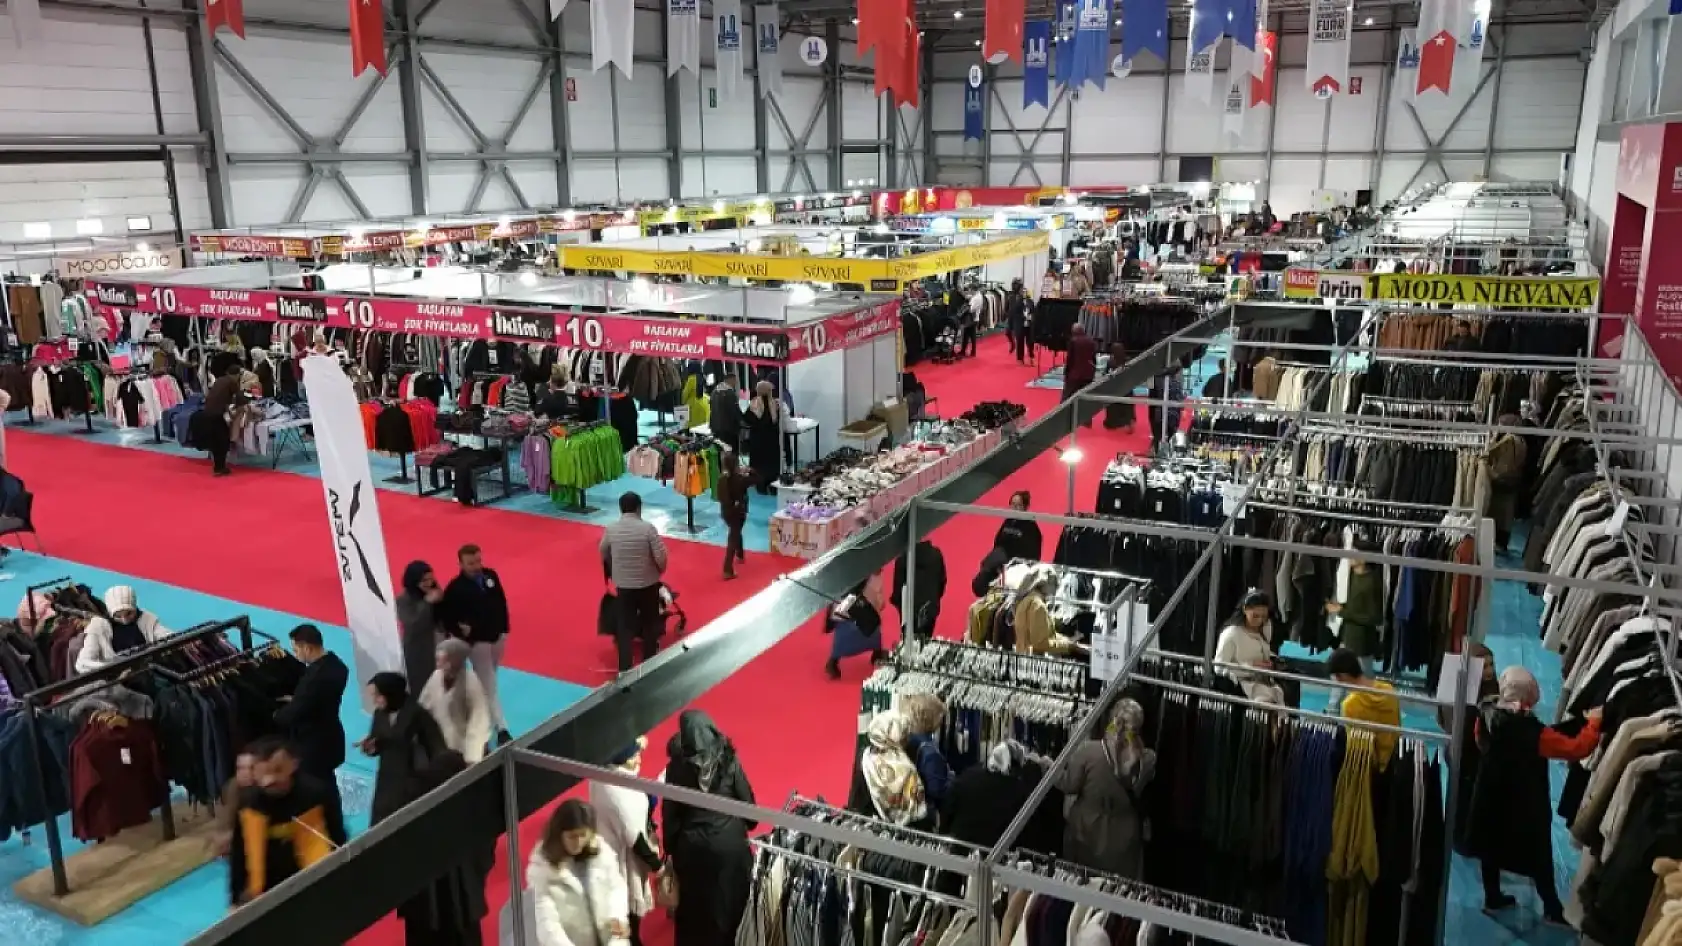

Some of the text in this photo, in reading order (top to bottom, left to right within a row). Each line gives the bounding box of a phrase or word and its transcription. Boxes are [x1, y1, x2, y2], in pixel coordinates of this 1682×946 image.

[803, 264, 850, 280] SÜVARİ
[151, 287, 176, 313] 10
[1320, 280, 1362, 298] ürün
[1389, 279, 1593, 306] MODA NIRVANA
[344, 300, 375, 328] 10
[566, 317, 603, 348] 10
[802, 321, 826, 355] 10
